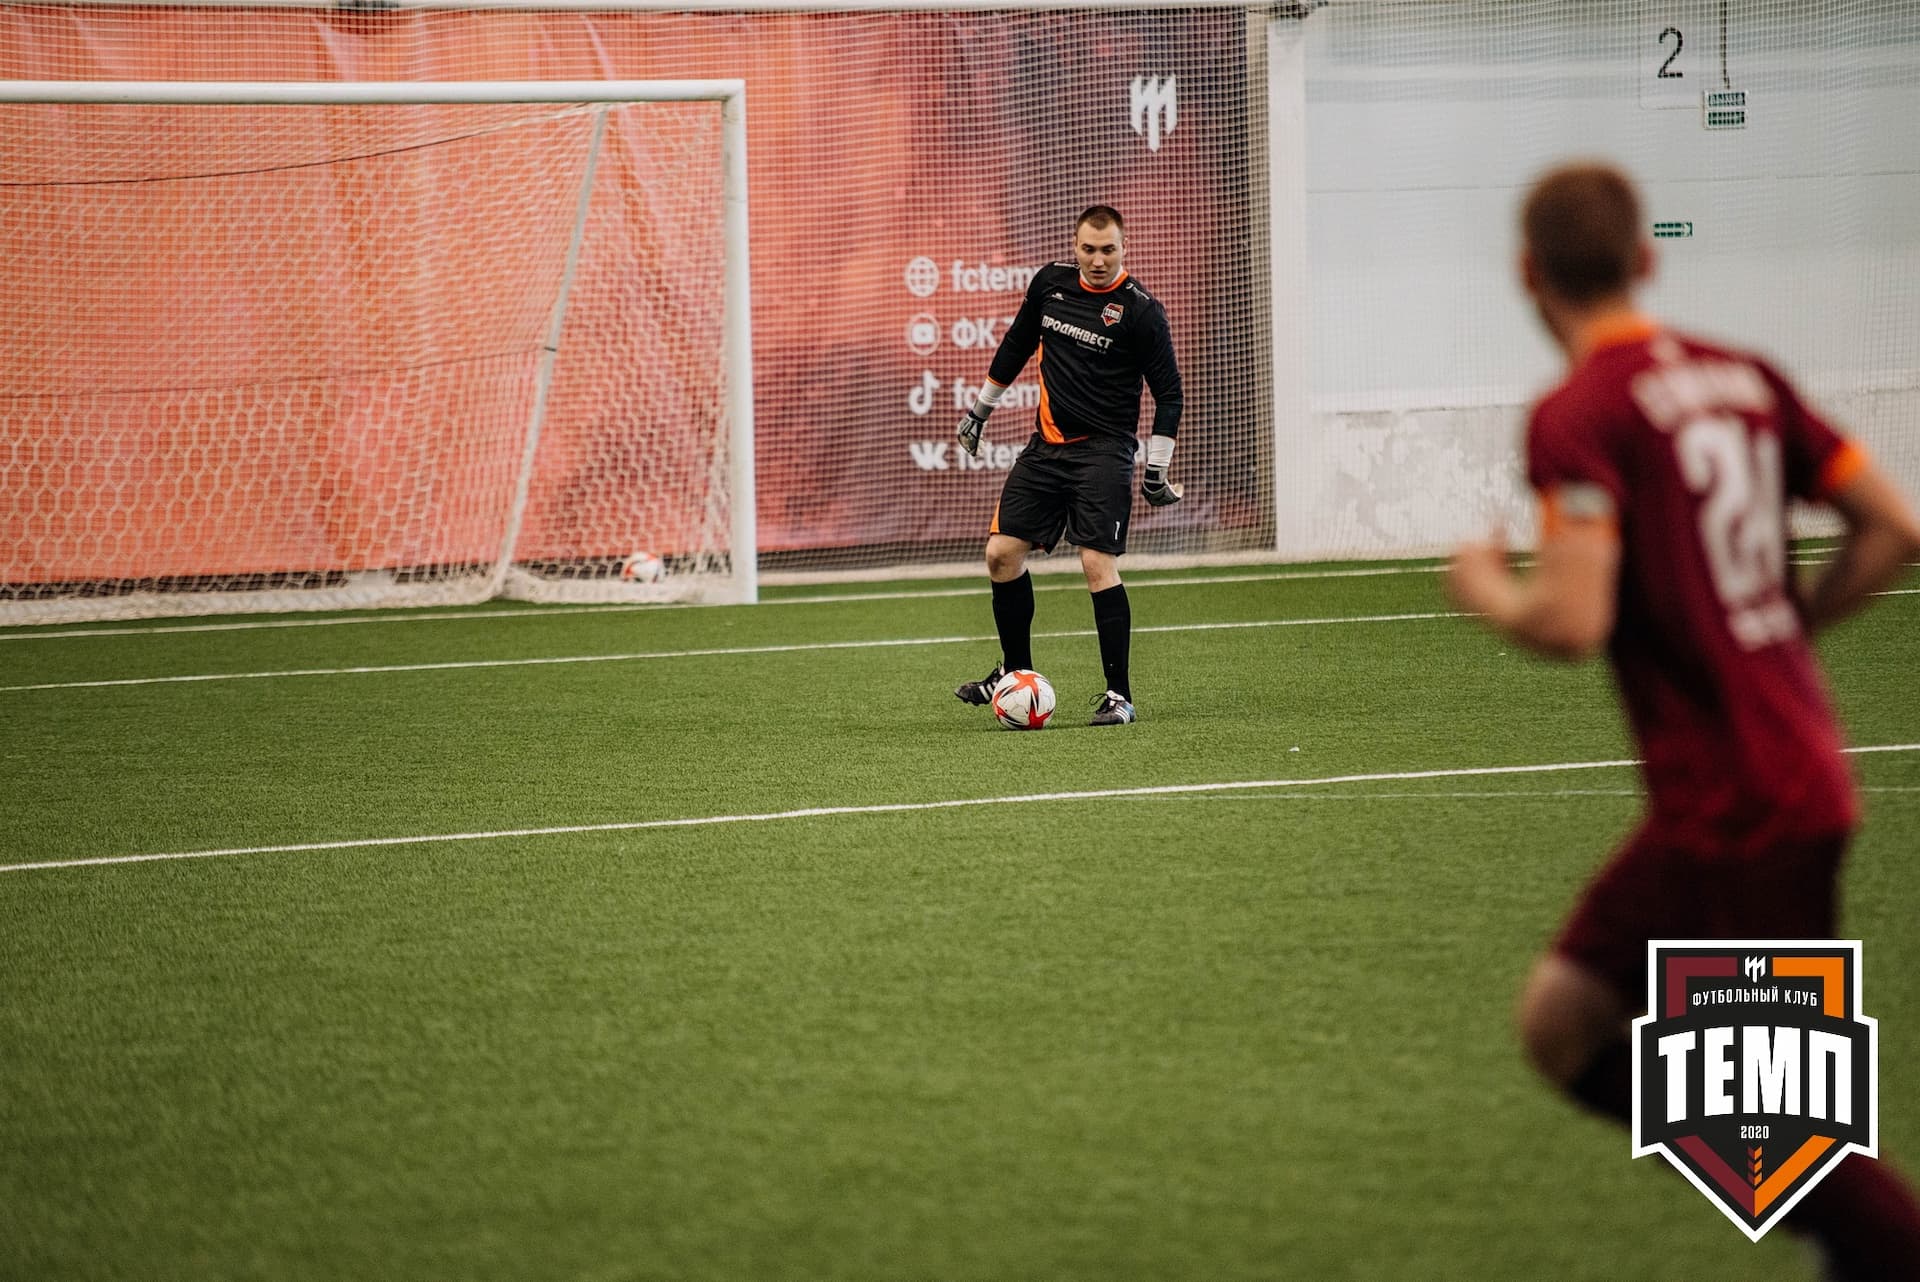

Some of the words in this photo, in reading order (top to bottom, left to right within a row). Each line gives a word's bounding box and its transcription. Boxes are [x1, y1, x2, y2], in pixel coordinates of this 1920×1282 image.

[1657, 27, 1683, 78] 2
[952, 260, 1044, 292] fctem
[952, 317, 997, 348] ФК
[1041, 314, 1113, 349] ПРОДИНВЕСТ
[1115, 521, 1120, 540] 1
